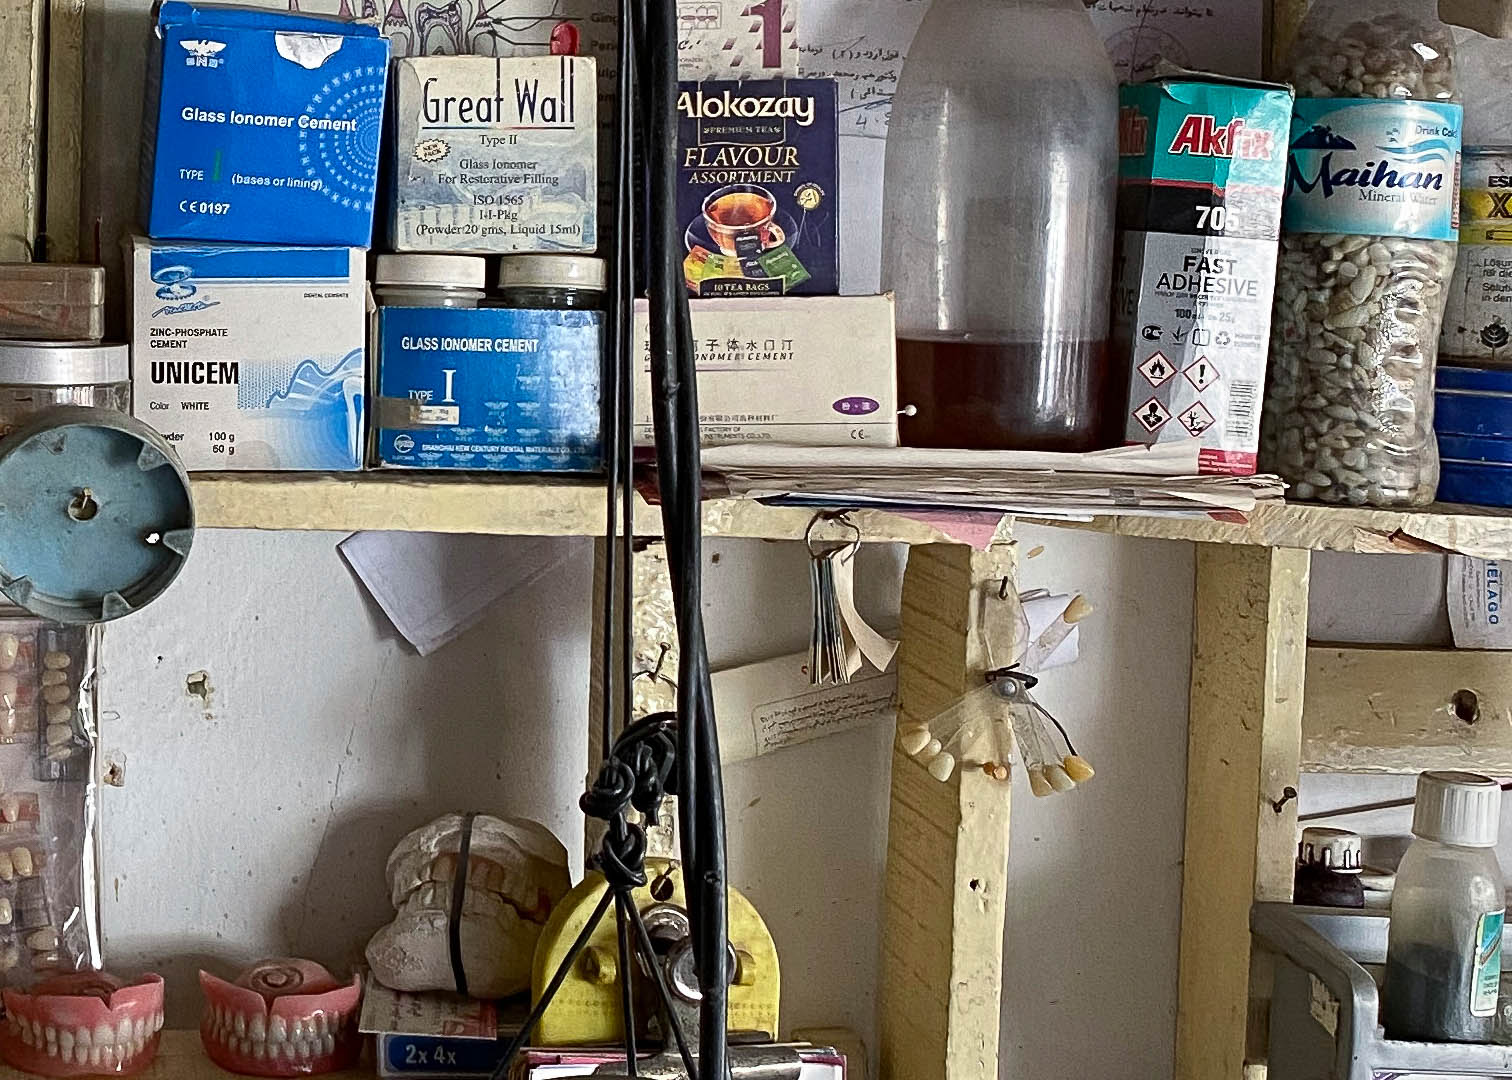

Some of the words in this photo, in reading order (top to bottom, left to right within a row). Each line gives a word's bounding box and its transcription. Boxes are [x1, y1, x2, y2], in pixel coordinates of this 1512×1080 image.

[422, 64, 503, 123] Great
[514, 60, 574, 123] Wall
[677, 91, 815, 126] Alokozay
[182, 107, 226, 124] Glass
[230, 111, 295, 128] Ionomer
[298, 115, 357, 132] Cement
[480, 135, 500, 147] Type
[503, 135, 517, 146] II
[1170, 114, 1274, 159] Akfix
[460, 159, 488, 170] Glass
[492, 160, 537, 171] Ionomer
[684, 147, 800, 167] FLAVOUR
[180, 169, 203, 182] TYPE
[232, 173, 270, 189] (bases
[273, 177, 282, 187] or
[285, 175, 323, 191] lining)
[439, 174, 455, 185] For
[459, 174, 519, 185] Restorative
[523, 174, 558, 188] Filling
[689, 171, 794, 184] ASSORTMENT
[1289, 151, 1442, 200] Maihan
[199, 202, 230, 215] 0197
[473, 195, 494, 206] ISO
[498, 195, 523, 206] 1565
[1196, 206, 1240, 230] 705
[416, 224, 462, 237] (Powder
[466, 225, 476, 234] 20
[479, 227, 505, 238] gms,
[509, 223, 545, 237] Liquid
[549, 224, 580, 236] 15ml)
[1183, 256, 1237, 274] FAST
[725, 283, 745, 291] TEA
[747, 283, 770, 291] BAGS
[1156, 273, 1258, 296] ADHESIVE
[150, 328, 228, 338] ZINC-PHOSPHATE
[150, 340, 187, 349] CEMENT
[402, 337, 439, 352] GLASS
[441, 338, 492, 352] IONOMER
[494, 338, 538, 354] CEMENT
[748, 352, 794, 360] CEMENT
[151, 361, 239, 385] UNICEM
[408, 390, 433, 401] TYPE
[443, 369, 456, 403] I
[150, 401, 169, 410] Color
[181, 401, 209, 410] WHITE
[208, 432, 226, 441] 100
[406, 1045, 427, 1064] 2x
[434, 1045, 456, 1064] 4x
